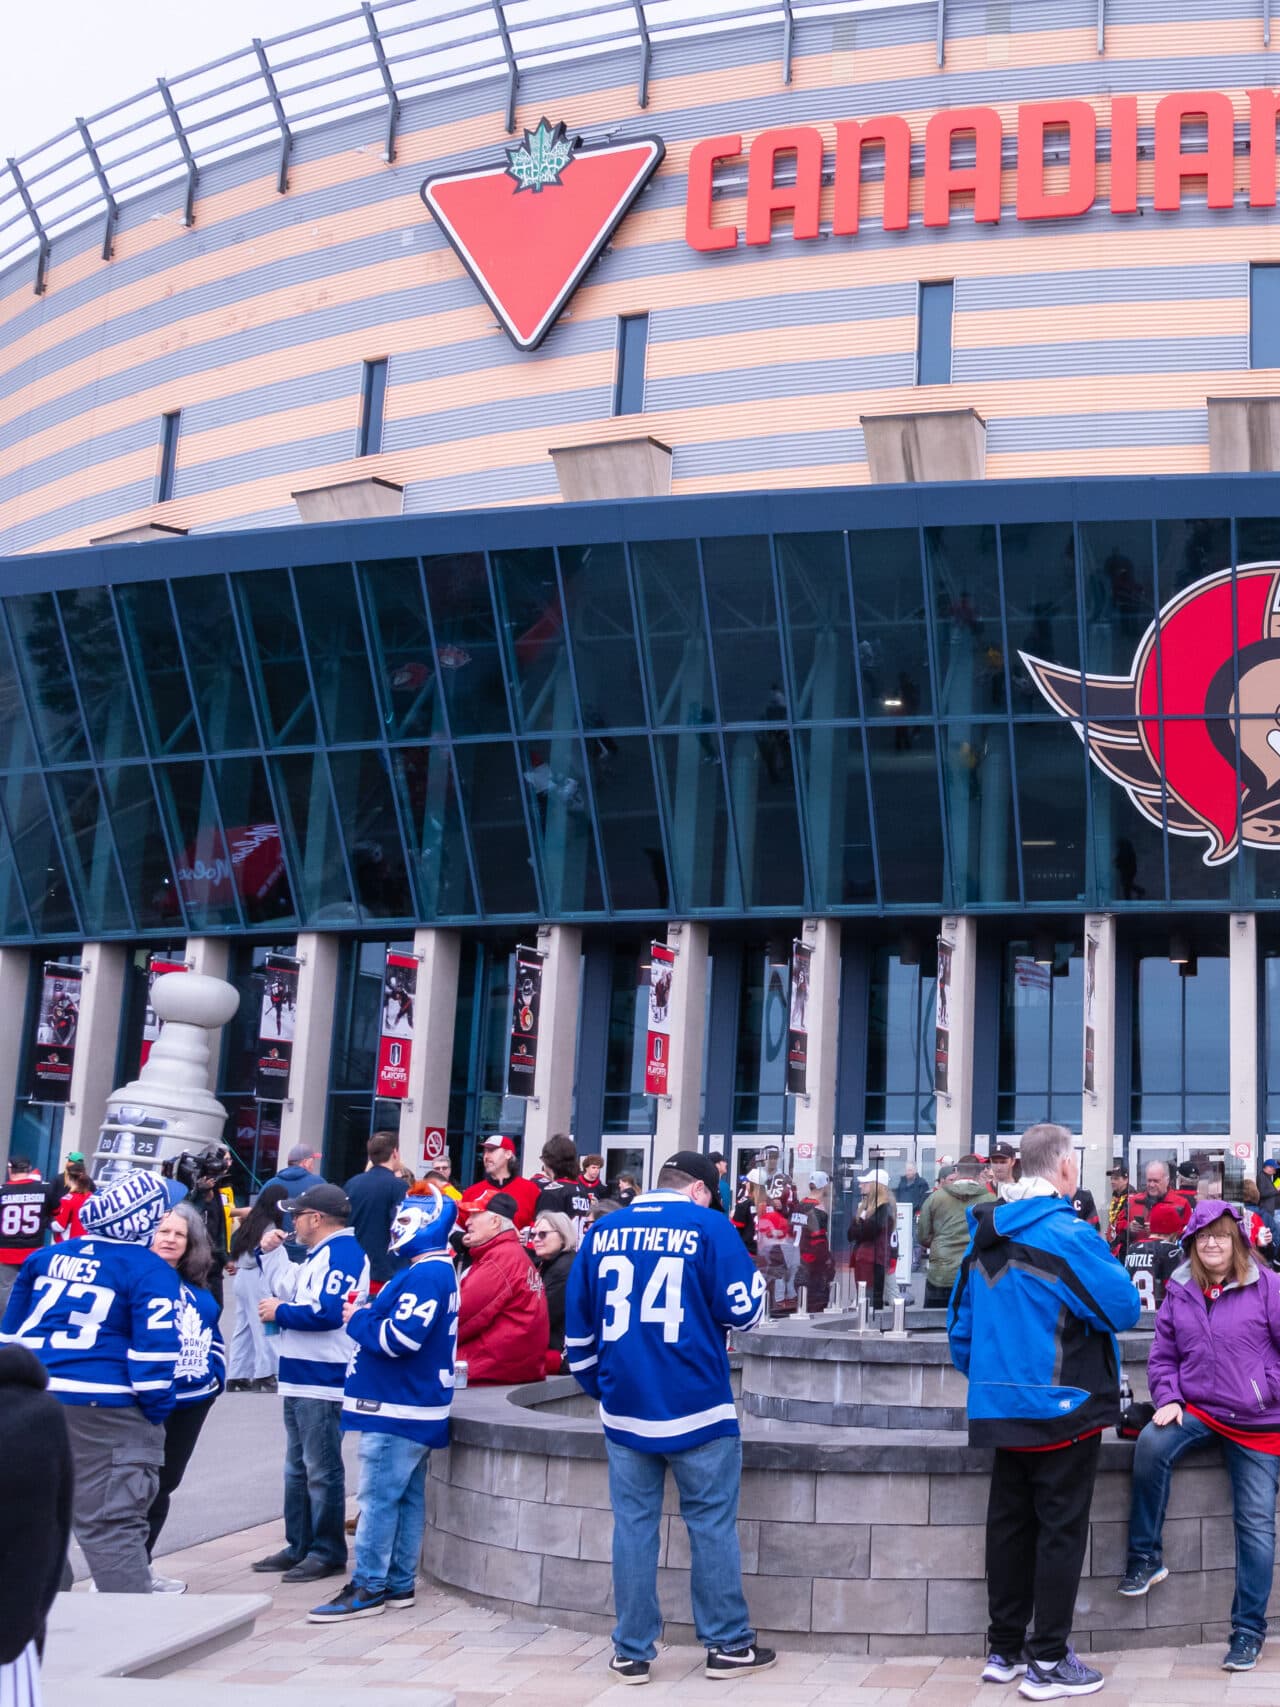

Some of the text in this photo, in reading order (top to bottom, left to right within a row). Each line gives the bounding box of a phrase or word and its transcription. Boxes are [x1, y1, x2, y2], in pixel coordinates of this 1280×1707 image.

[137, 1142, 154, 1153] 25
[2, 1204, 41, 1235] 85
[592, 1227, 699, 1255] MATTHEWS
[48, 1254, 101, 1283] KNIES
[1124, 1252, 1154, 1267] TÜTZLE
[598, 1255, 685, 1343] 34
[726, 1270, 766, 1316] 34
[17, 1275, 116, 1349] 23
[395, 1292, 438, 1327] 34
